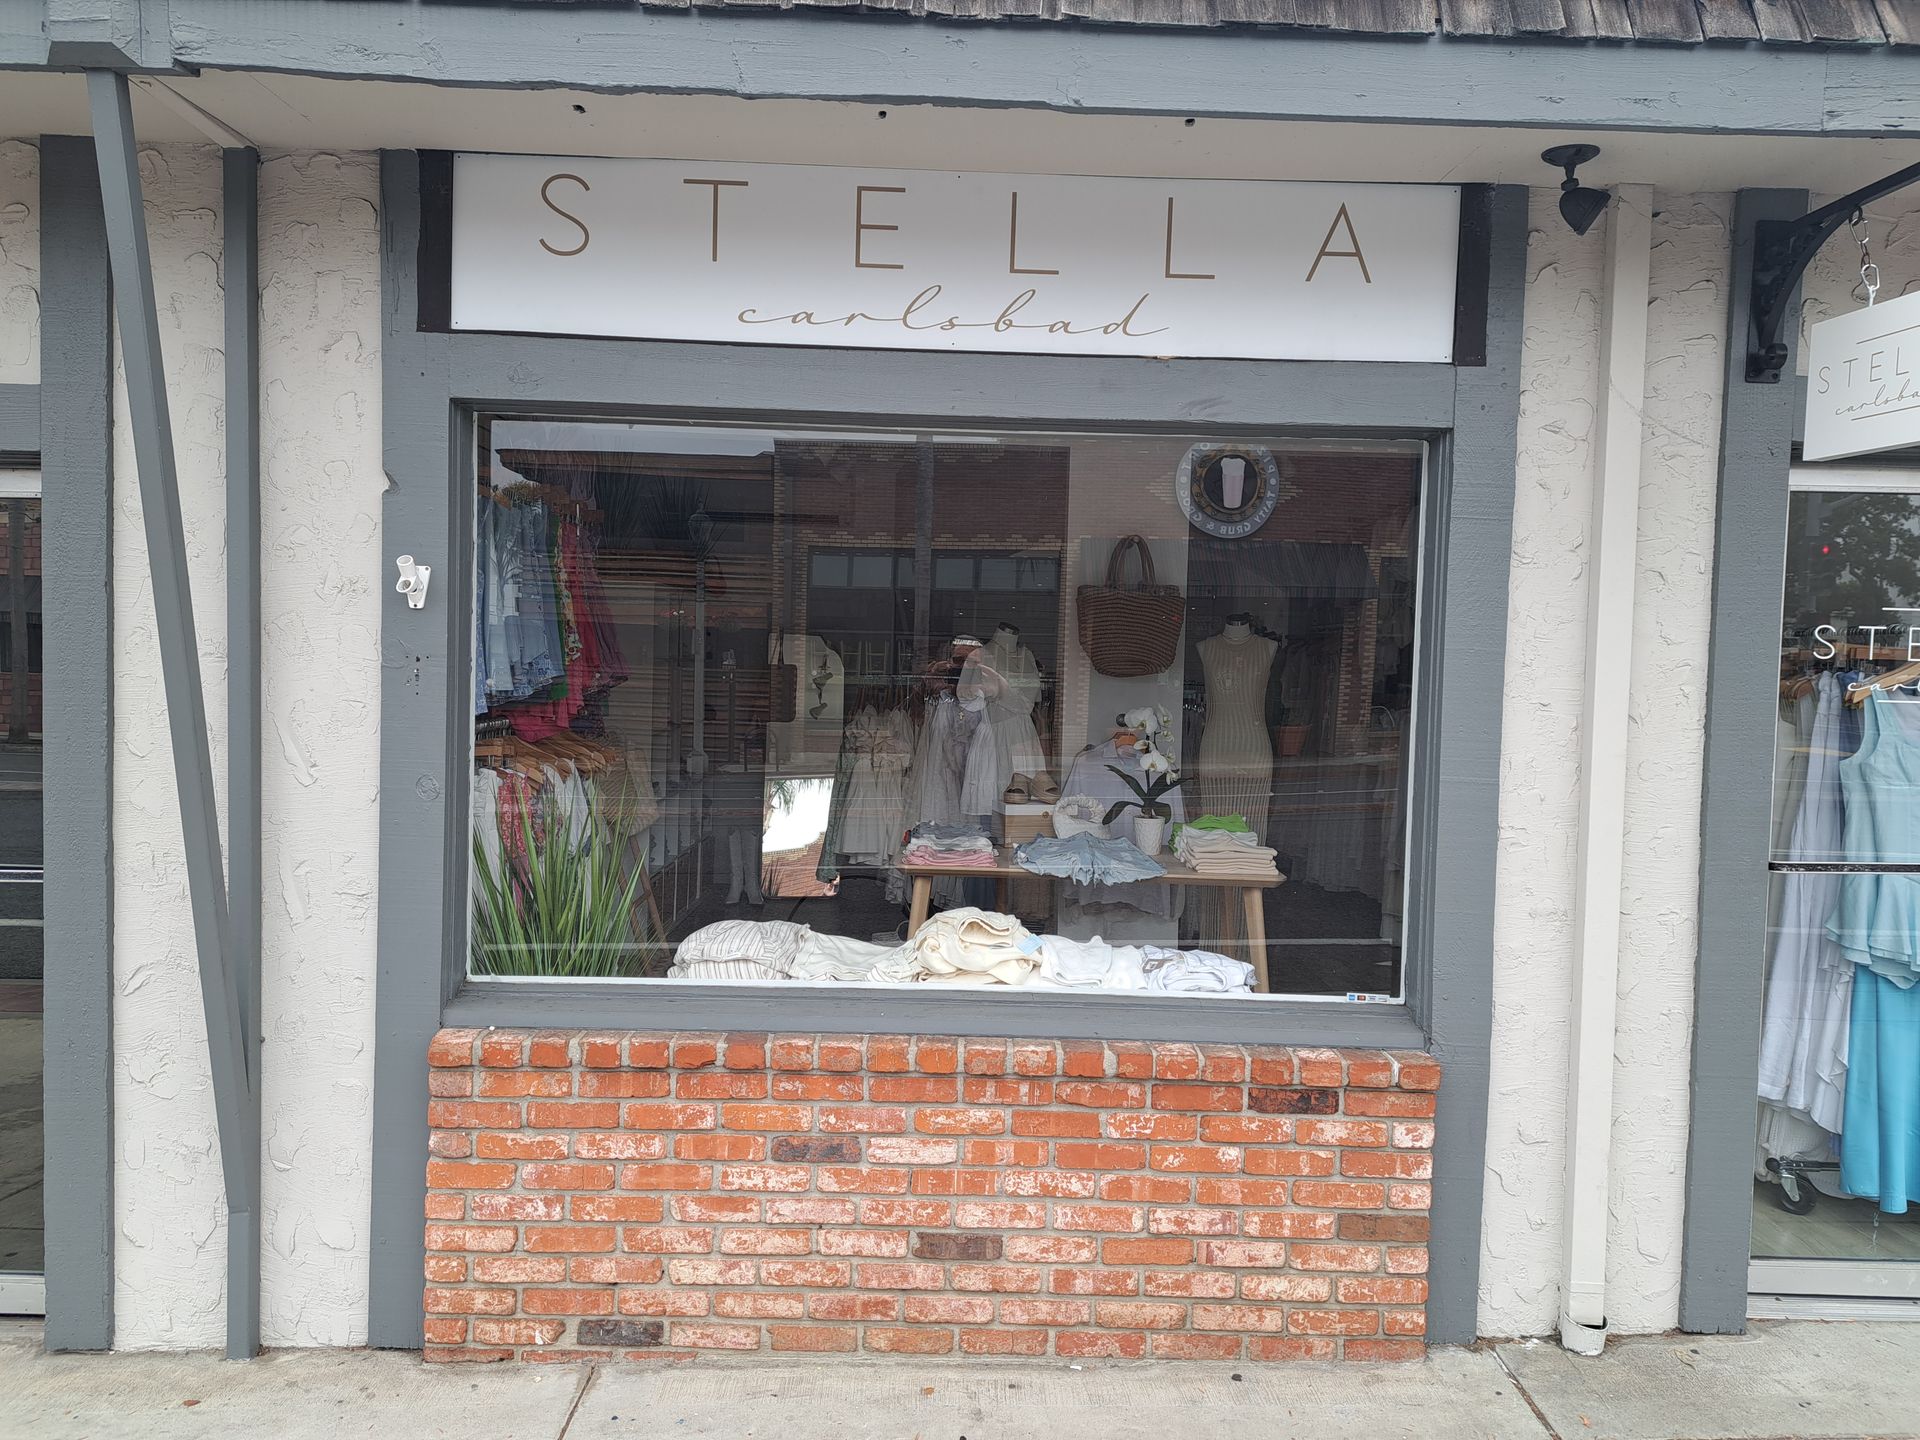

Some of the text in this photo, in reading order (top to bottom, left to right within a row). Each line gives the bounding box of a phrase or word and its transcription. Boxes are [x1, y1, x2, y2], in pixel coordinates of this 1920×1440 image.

[539, 173, 1372, 284] STELLA
[737, 284, 1170, 337] carlsbad
[1817, 346, 1910, 395] STEL
[1847, 680, 1920, 692] car
